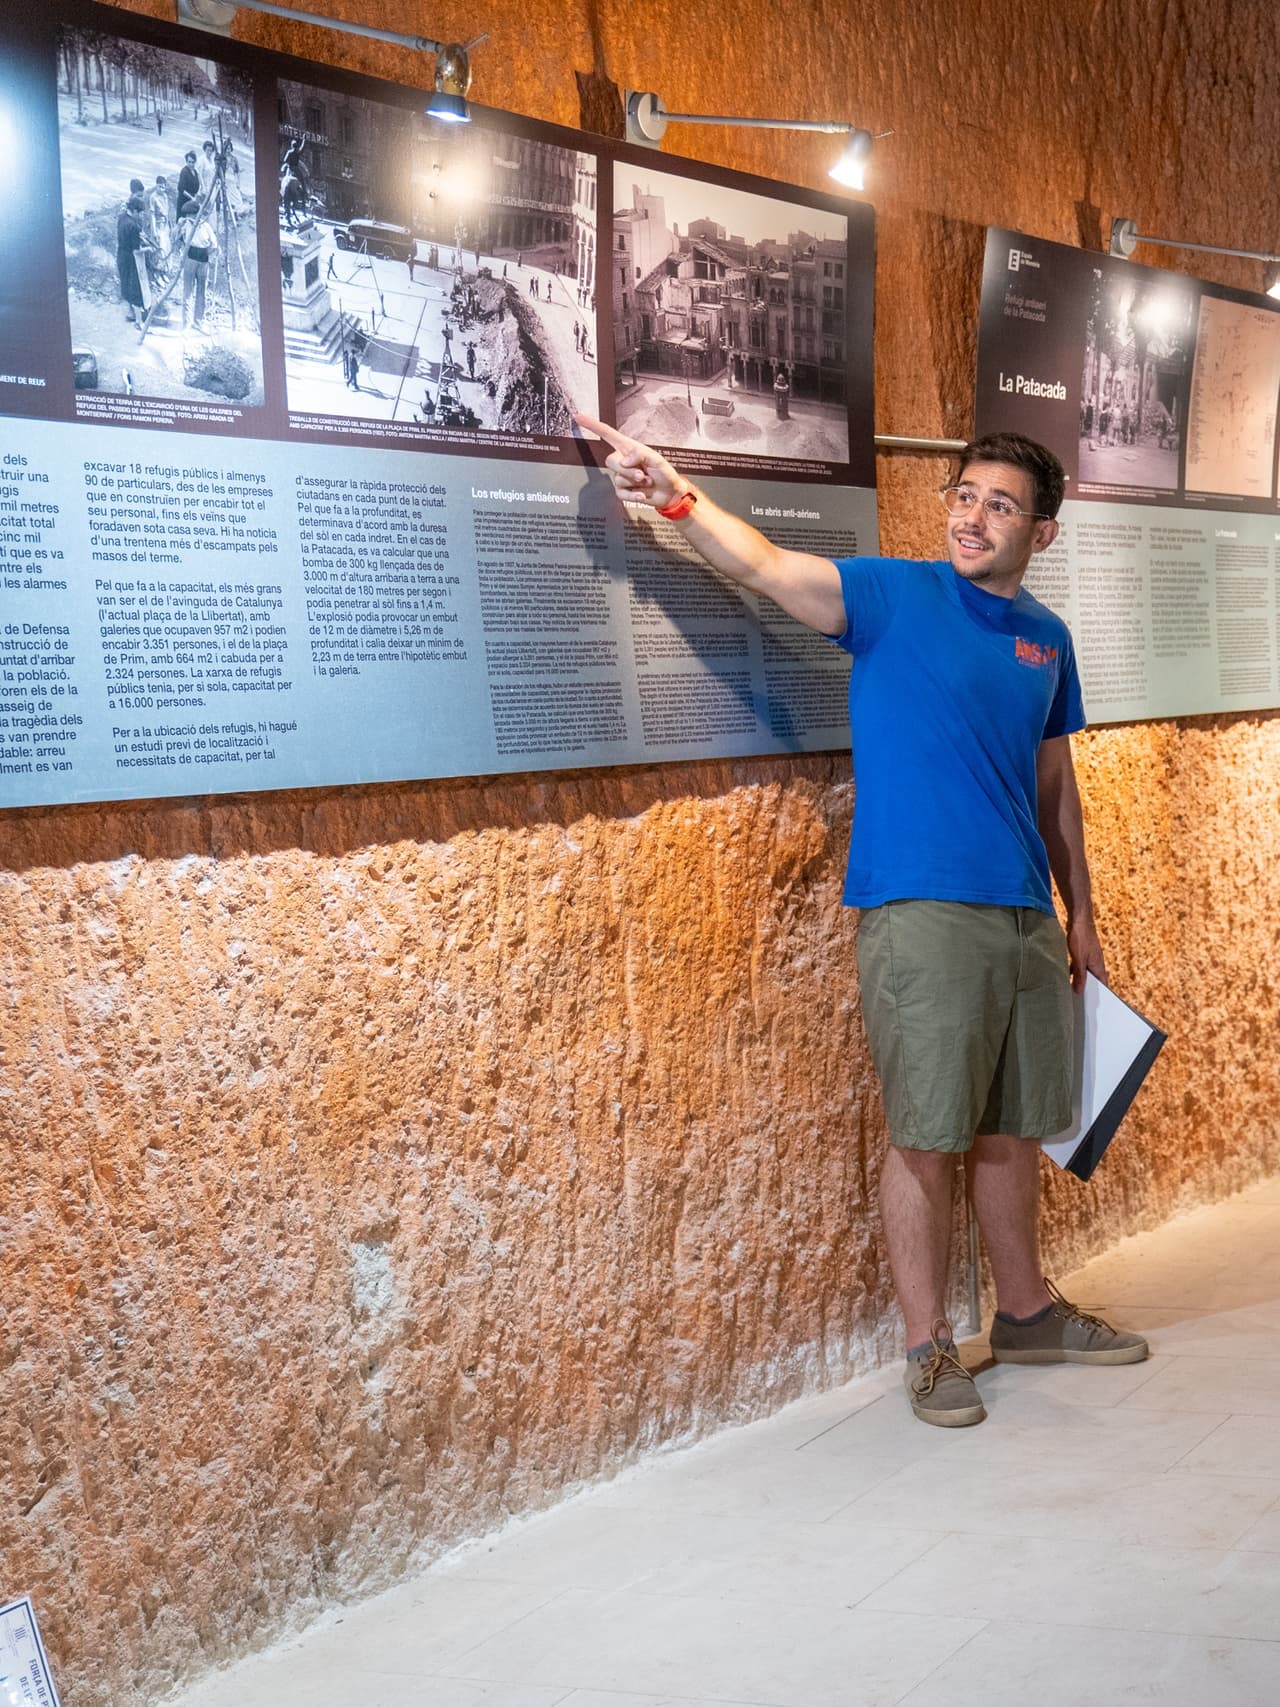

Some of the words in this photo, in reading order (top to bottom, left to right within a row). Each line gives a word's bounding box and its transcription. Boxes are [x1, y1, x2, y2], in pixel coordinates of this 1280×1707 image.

[28, 378, 46, 386] REUS
[1000, 372, 1013, 392] La
[1016, 375, 1066, 400] Patacada
[3, 454, 28, 466] dels
[28, 474, 49, 483] una
[84, 475, 98, 486] 90
[100, 476, 114, 487] de
[117, 477, 174, 493] particulars,
[176, 480, 195, 492] des
[196, 481, 209, 493] de
[211, 482, 226, 494] les
[228, 485, 273, 498] empreses
[296, 488, 340, 501] ciutadans
[342, 493, 353, 502] en
[355, 492, 377, 503] cada
[378, 494, 398, 507] punt
[399, 494, 410, 505] de
[412, 495, 420, 506] la
[421, 495, 446, 507] ciutat.
[472, 487, 488, 498] Los
[490, 489, 525, 502] refugios
[527, 492, 570, 503] antiaéreos
[0, 500, 17, 512] mil
[20, 502, 59, 514] metres
[752, 505, 763, 515] Les
[765, 507, 781, 517] abris
[88, 507, 107, 516] seu
[110, 506, 159, 521] personal,
[162, 508, 180, 520] fins
[183, 509, 198, 521] els
[200, 510, 226, 522] veïns
[228, 514, 246, 525] que
[30, 517, 55, 529] total
[24, 532, 41, 543] mil
[10, 549, 32, 560] que
[34, 550, 48, 559] es
[50, 551, 64, 560] va
[301, 543, 310, 554] la
[311, 543, 356, 556] Patacada,
[358, 547, 368, 556] es
[370, 547, 381, 556] va
[382, 546, 415, 557] calcular
[417, 549, 432, 560] que
[434, 550, 449, 558] una
[26, 563, 42, 574] els
[4, 577, 21, 588] les
[23, 578, 67, 590] alarmes
[96, 597, 116, 605] van
[119, 597, 135, 606] ser
[138, 595, 148, 606] el
[150, 595, 164, 606] de
[166, 596, 218, 609] l'avinguda
[220, 596, 233, 607] de
[235, 596, 283, 610] Catalunya
[307, 611, 353, 624] L'explosió
[354, 611, 380, 624] podia
[381, 614, 418, 624] provocar
[420, 614, 430, 622] un
[432, 612, 458, 622] embut
[5, 624, 20, 635] de
[22, 624, 70, 635] Defensa
[100, 624, 141, 637] galeries
[142, 626, 162, 637] que
[164, 626, 212, 637] ocupaven
[214, 624, 231, 635] 957
[233, 624, 248, 635] m2
[250, 624, 253, 635] i
[255, 624, 286, 637] podien
[54, 639, 68, 650] de
[30, 654, 75, 665] d'arribar
[312, 651, 331, 663] 2,23
[332, 653, 342, 661] m
[343, 651, 355, 661] de
[356, 652, 377, 661] terra
[378, 652, 400, 661] entre
[401, 650, 440, 663] l'hipotètic
[442, 650, 467, 661] embut
[3, 670, 14, 680] la
[17, 669, 70, 682] població.
[105, 668, 134, 679] 2.324
[137, 669, 188, 680] persones.
[190, 667, 203, 678] La
[206, 669, 233, 678] xarxa
[235, 666, 248, 677] de
[250, 666, 282, 679] refugis
[30, 684, 48, 695] els
[50, 684, 65, 695] de
[68, 684, 78, 695] la
[38, 700, 52, 711] de
[11, 715, 58, 728] tragèdia
[60, 714, 83, 726] dels
[8, 733, 30, 742] van
[32, 729, 76, 743] prendre
[36, 747, 66, 757] arreu
[116, 754, 176, 768] necessitats
[178, 753, 192, 764] de
[194, 750, 243, 765] capacitat,
[245, 751, 261, 763] per
[263, 748, 276, 760] tal
[36, 763, 50, 772] es
[52, 762, 73, 771] van
[20, 1676, 29, 1688] DE
[29, 1659, 42, 1686] FORÇA
[37, 1687, 46, 1698] DE
